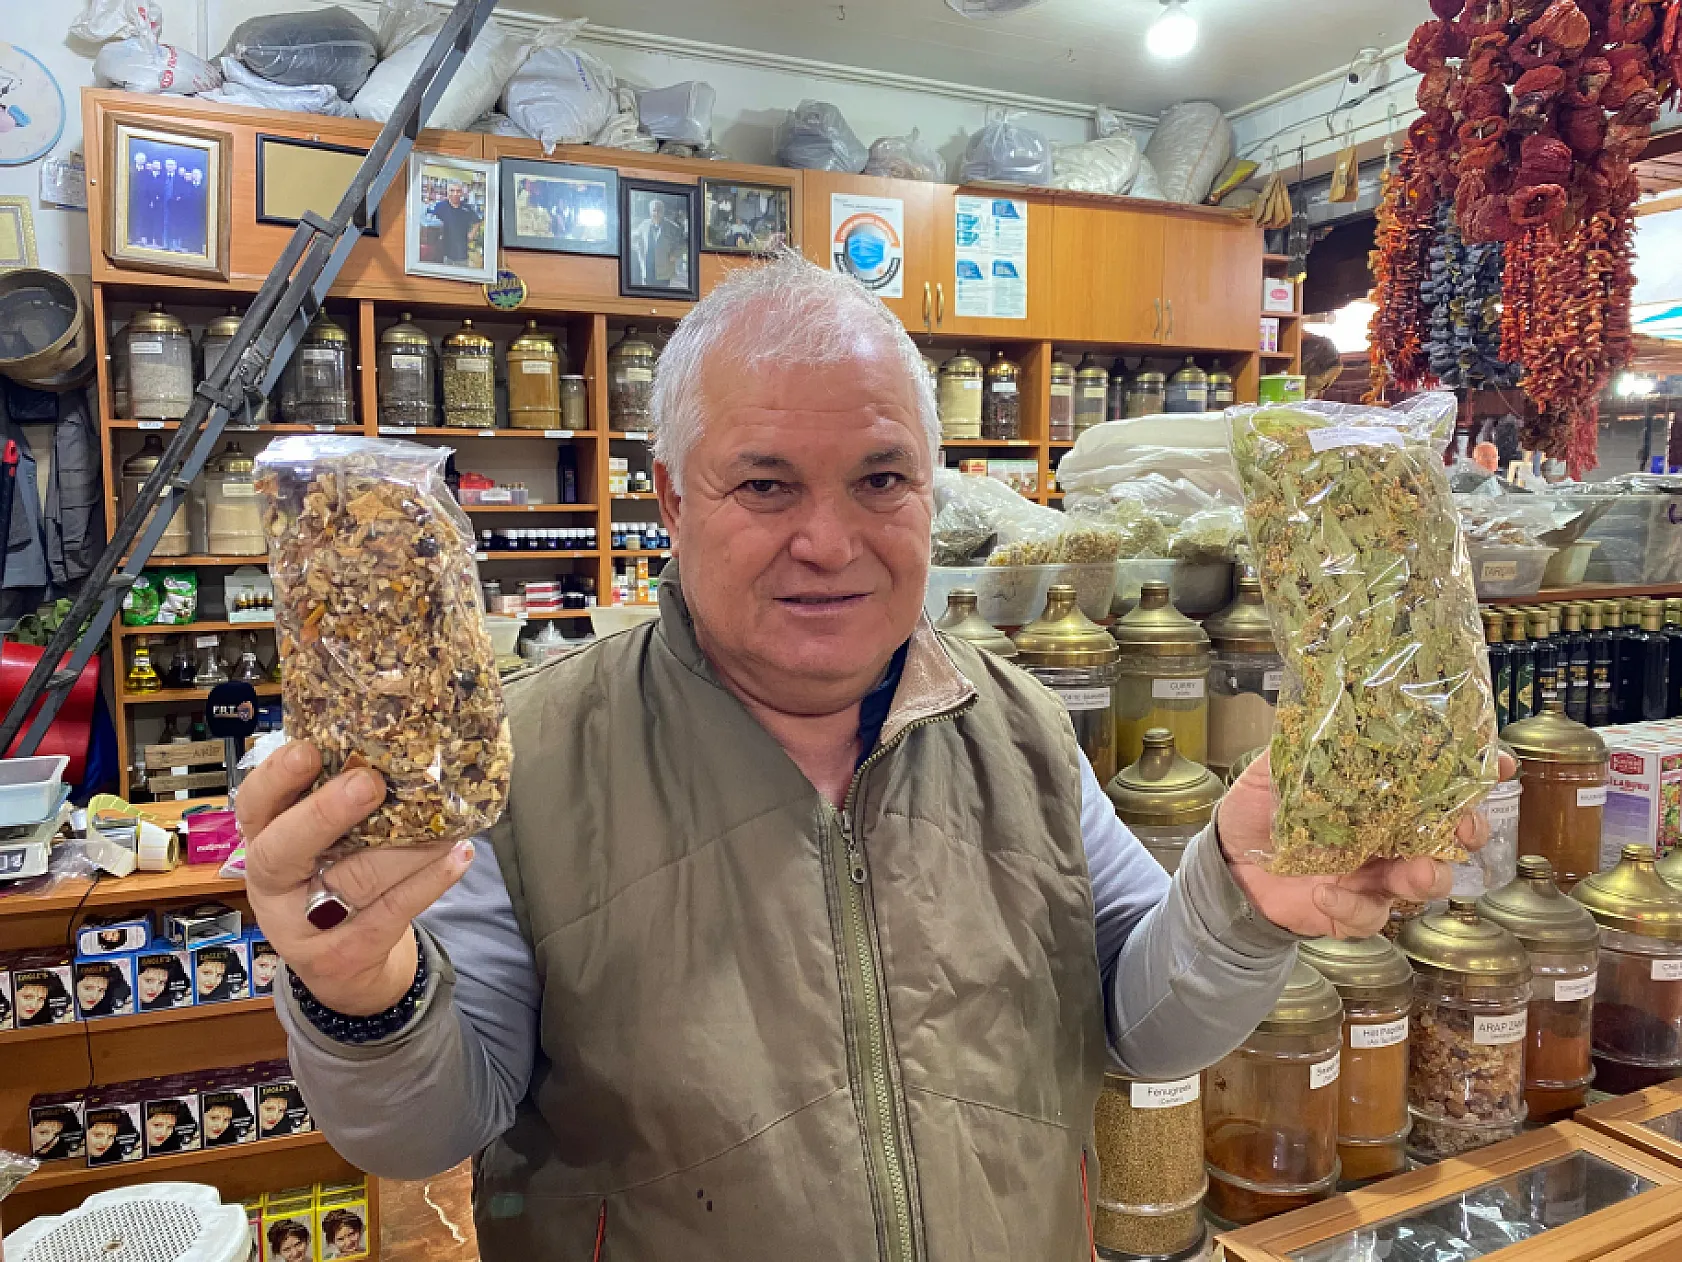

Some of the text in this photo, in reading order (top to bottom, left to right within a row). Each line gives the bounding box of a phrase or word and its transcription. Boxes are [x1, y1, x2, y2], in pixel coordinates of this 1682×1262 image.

[1169, 682, 1196, 691] CURRY
[1478, 1021, 1508, 1033] ARAP
[1147, 1082, 1192, 1098] Fenugreek
